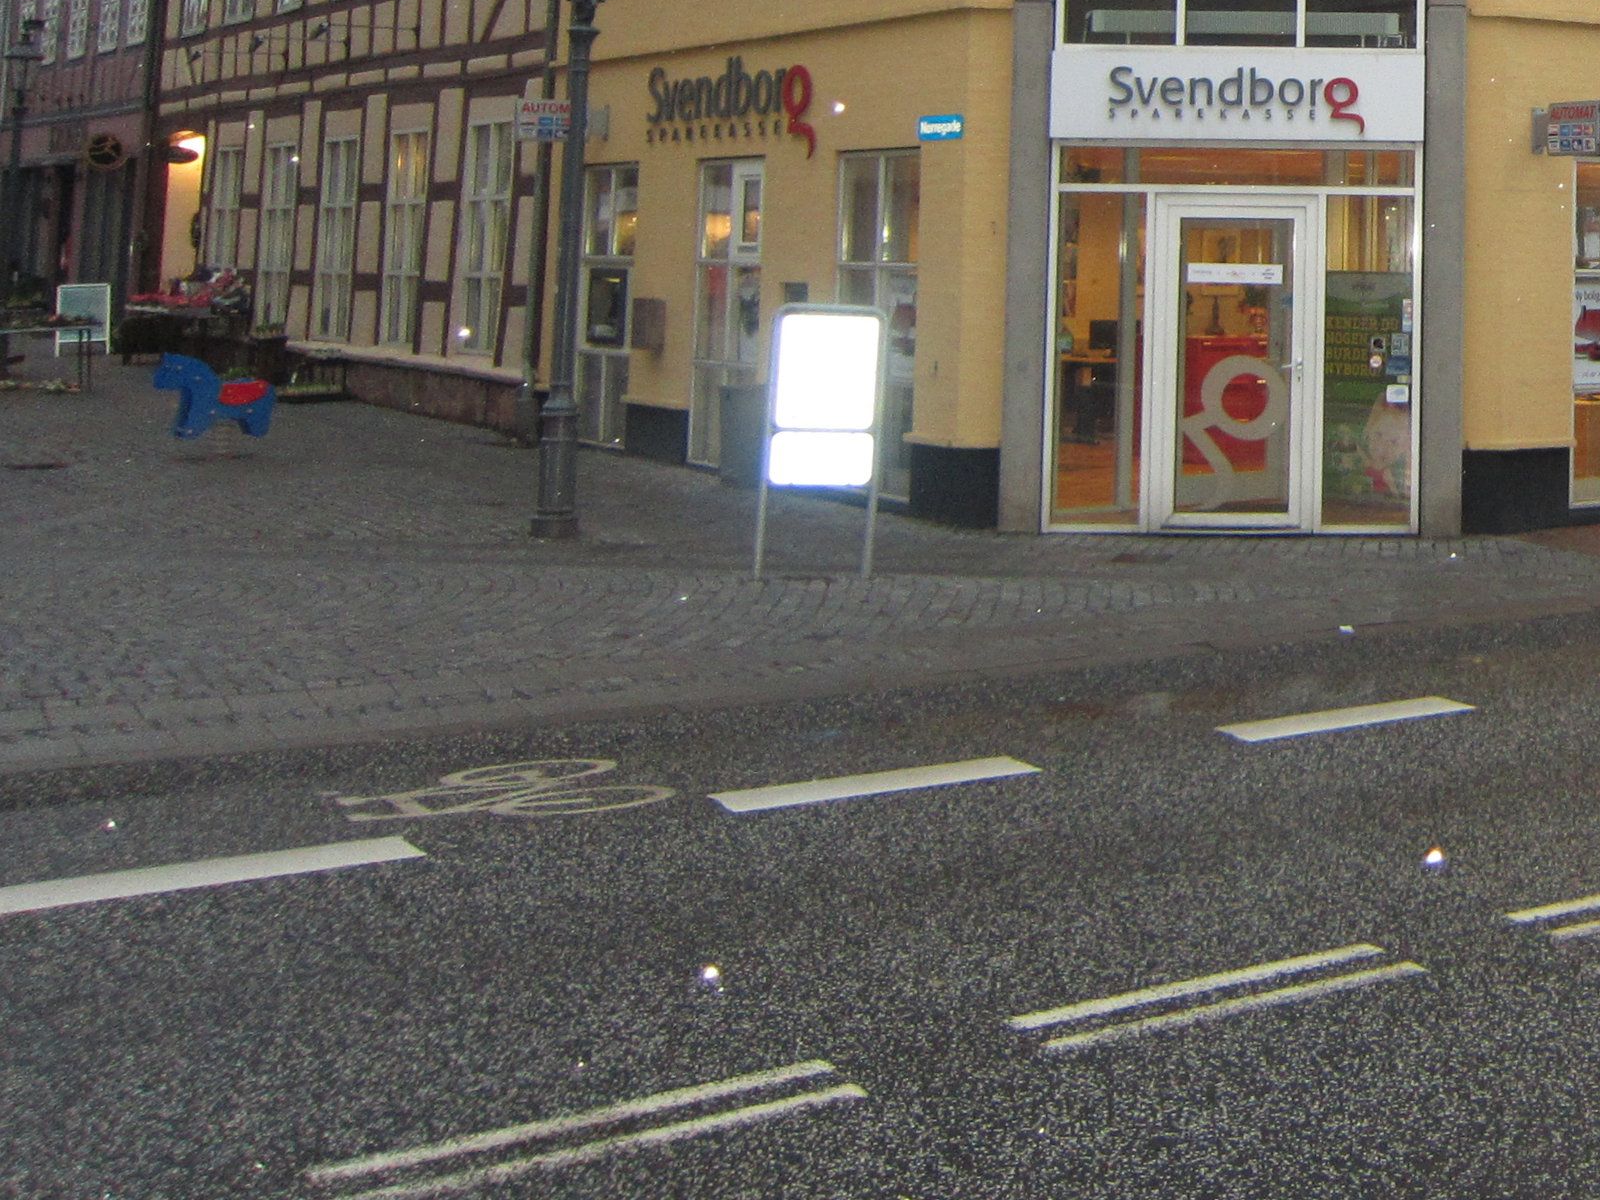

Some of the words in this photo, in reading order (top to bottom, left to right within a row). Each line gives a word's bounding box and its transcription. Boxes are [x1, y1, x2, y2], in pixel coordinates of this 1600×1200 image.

[522, 101, 572, 114] AUTOM
[647, 55, 816, 159] Svendborg
[1108, 66, 1365, 135] Svendborg
[1108, 107, 1317, 120] SPAREKASSE
[1551, 105, 1597, 120] AUTOMAT
